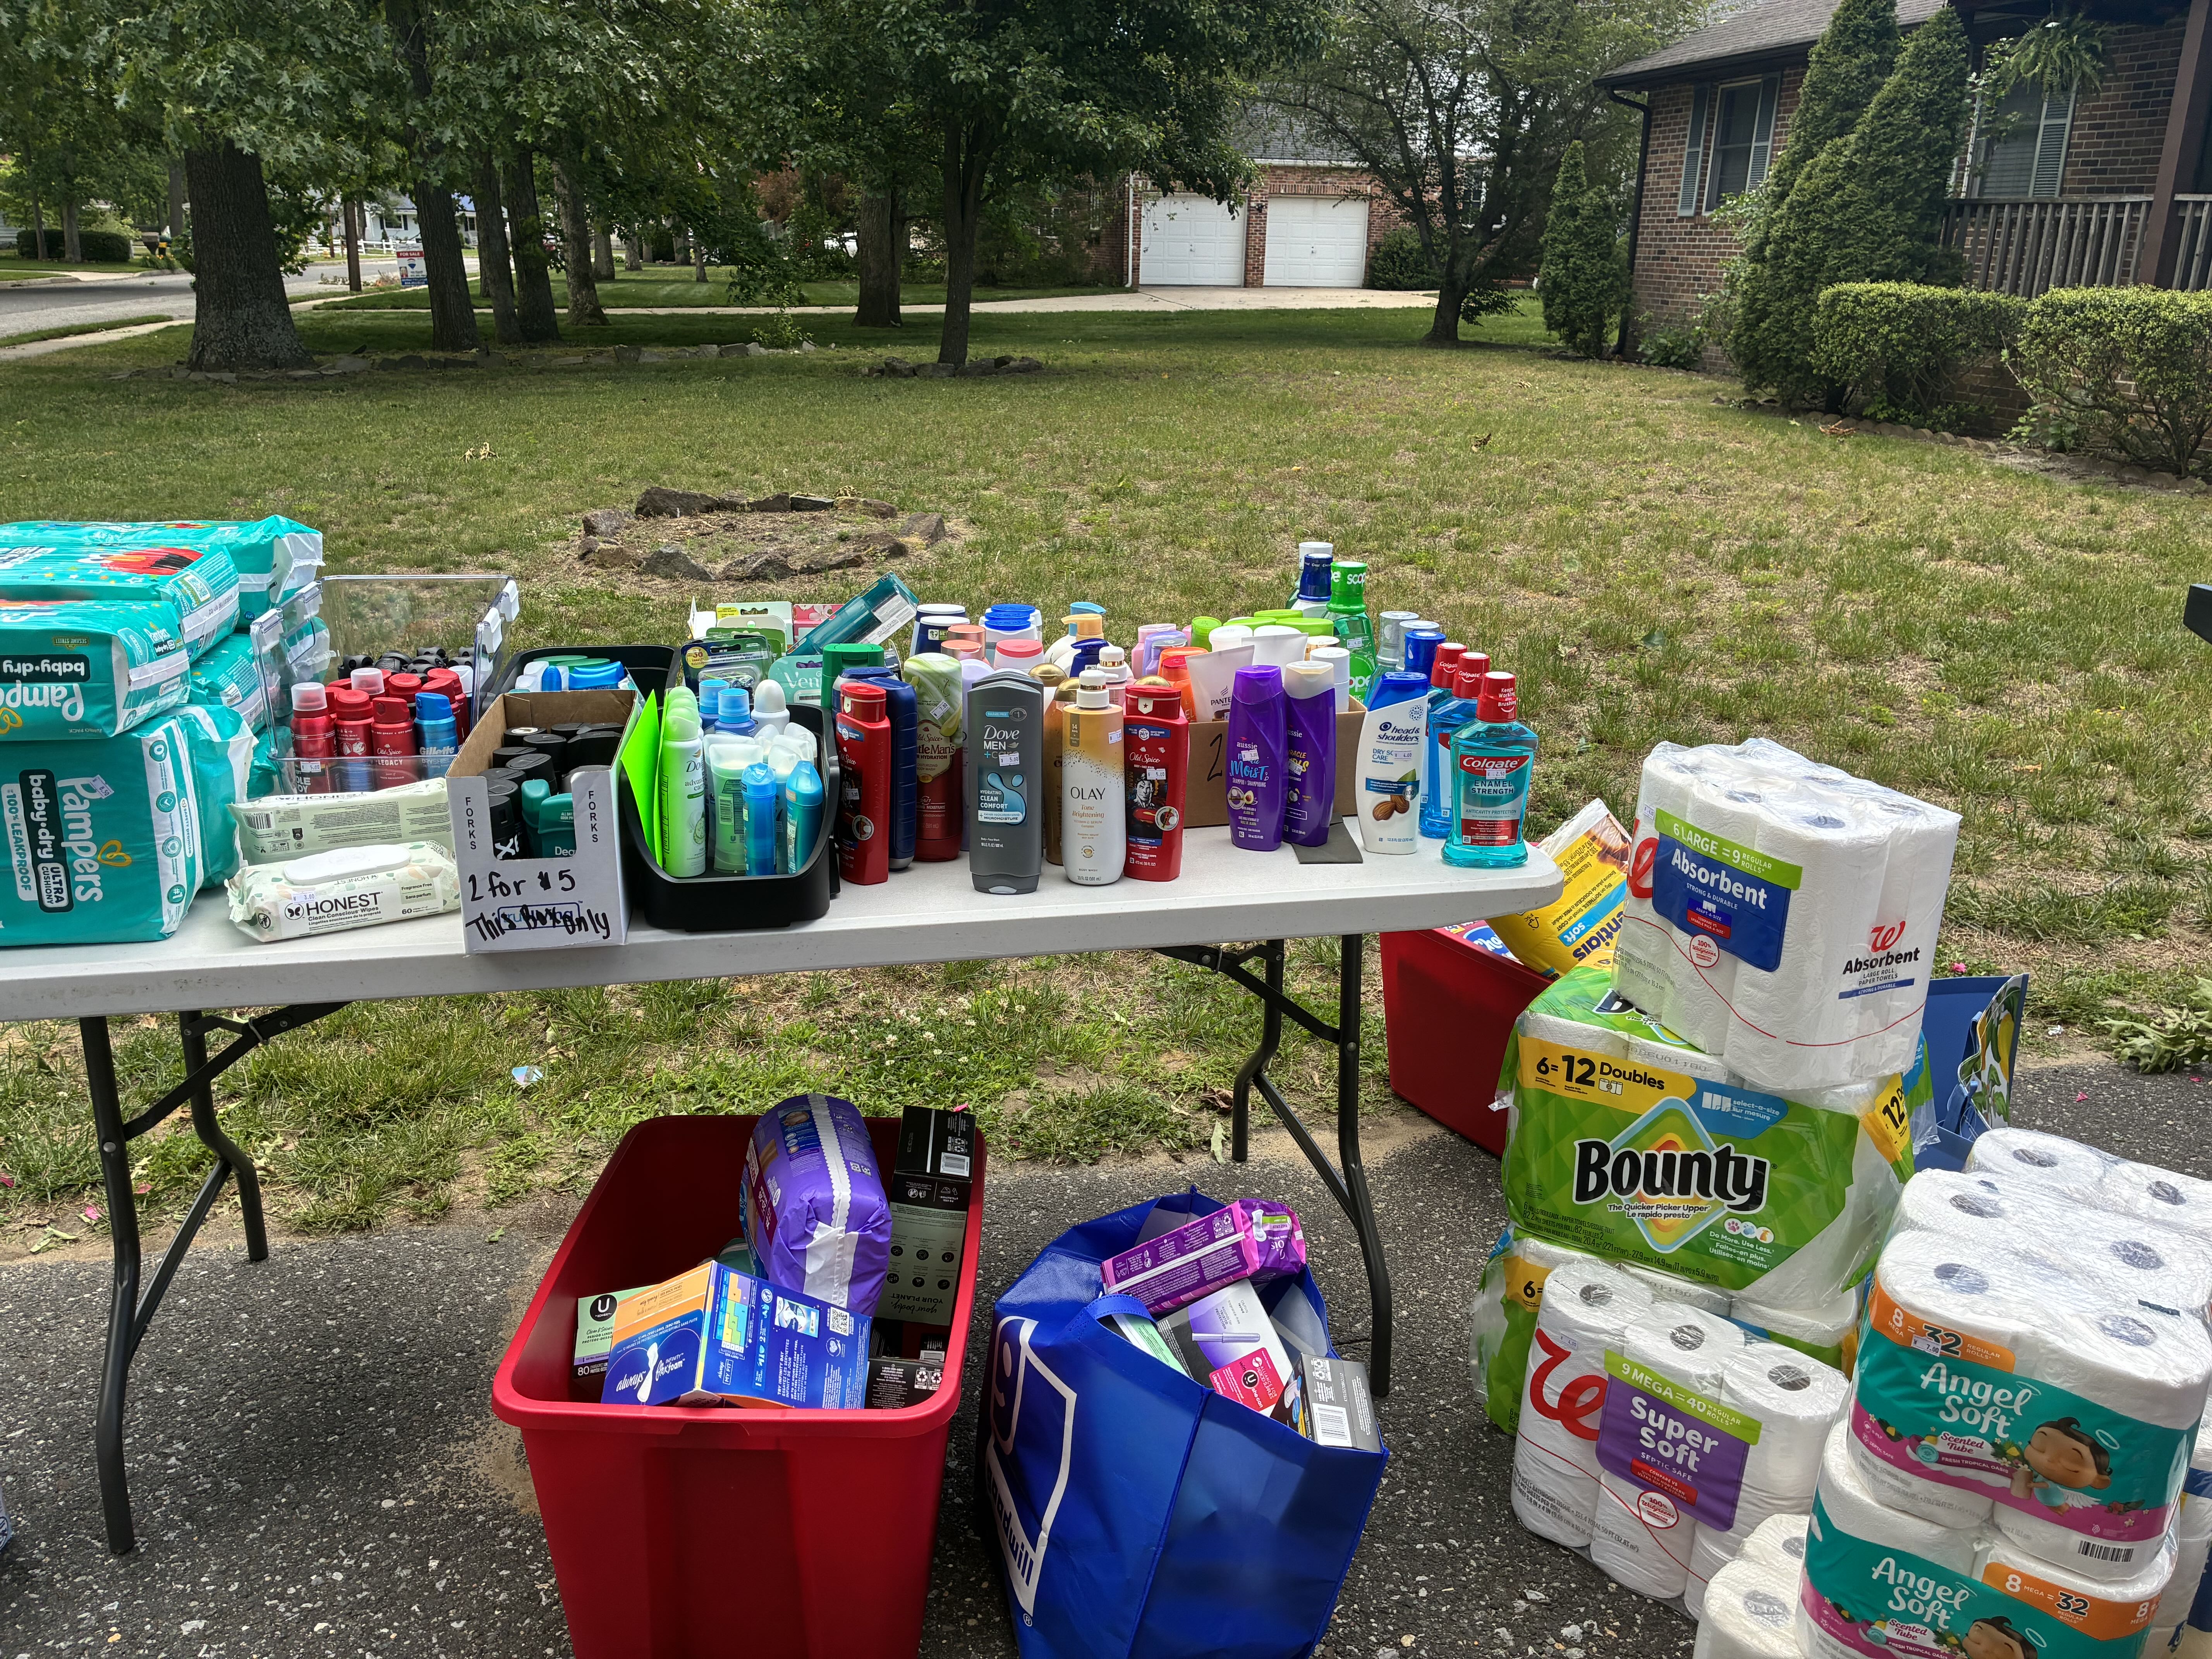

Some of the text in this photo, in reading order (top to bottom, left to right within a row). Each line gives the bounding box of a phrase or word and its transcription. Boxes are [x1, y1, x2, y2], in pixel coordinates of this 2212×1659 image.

[783, 671, 822, 689] Ven
[0, 680, 84, 721] Pamp
[1211, 697, 1232, 706] PANTE
[984, 725, 1020, 740] Dove
[1288, 730, 1302, 738] ussie
[1377, 734, 1419, 742] shoulders
[386, 747, 402, 756] Spice
[984, 740, 1006, 750] MEN
[1129, 752, 1160, 764] Old Spice
[1463, 757, 1518, 770] Colgate
[1232, 777, 1245, 786] SHAMPOO
[99, 785, 110, 797] 8.50
[1070, 787, 1106, 800] OLAY
[6, 793, 19, 821] 100%
[1072, 811, 1104, 819] Brightening
[465, 797, 477, 850] FORKS
[589, 790, 598, 843] FORKS
[58, 777, 103, 902] Pampers
[1673, 823, 1741, 864] 6 LARGE 9
[11, 823, 32, 891] LEAKPROOF
[1742, 853, 1772, 870] REGULAR
[42, 866, 54, 905] CUSHIONY
[50, 866, 64, 903] ULTRA
[334, 876, 369, 886] HONEST
[468, 874, 484, 902] 2
[488, 871, 526, 898] for
[1671, 848, 1767, 910] Absorbent
[1563, 870, 1616, 917] Encore plus DOUCEUR PRIX
[1686, 882, 1738, 910] STRONG DURABLE
[306, 891, 381, 916] HONEST
[326, 910, 359, 918] Conscious
[1573, 908, 1583, 918] Small
[1696, 907, 1722, 921] ADAPT-A-SIZE
[465, 912, 517, 942] This
[1557, 920, 1569, 931] COST
[1563, 922, 1586, 944] soft
[1692, 945, 1717, 957] Walgreens
[1697, 940, 1711, 948] 100%
[1842, 947, 1920, 975] Absorbent
[1859, 973, 1898, 986] PAPER TOWELS
[1863, 970, 1880, 979] LARGE
[1599, 1061, 1665, 1090] Doubles
[1733, 1099, 1780, 1116] select-a-size
[1745, 1110, 1771, 1121] mesure
[1882, 1096, 1905, 1130] 12
[1574, 1139, 1768, 1212] Bounty
[1637, 1211, 1662, 1219] rapido
[1721, 1233, 1740, 1245] More.
[1741, 1240, 1754, 1249] Use
[1632, 1250, 1665, 1267] 27.9 14.9
[1709, 1247, 1746, 1263] Utilisez-en
[1716, 1242, 1766, 1262] Faites-en plus.
[598, 1298, 610, 1313] U
[891, 1293, 921, 1302] PLANET
[916, 1303, 937, 1314] your
[1215, 1308, 1226, 1329] PROTECTION
[1892, 1308, 1904, 1328] 8
[1888, 1320, 1904, 1338] MEGA
[1926, 1344, 1939, 1353] 7.00
[1967, 1343, 2001, 1358] REGULAR
[578, 1366, 590, 1376] 80
[655, 1359, 683, 1381] flexfoam
[724, 1372, 730, 1382] MY
[1260, 1366, 1272, 1387] ALLIANCE
[616, 1371, 644, 1392] always
[1621, 1363, 1707, 1413] 9 MEGA 40
[1920, 1362, 2032, 1416] Angel
[1708, 1405, 1741, 1425] REGULAR
[1939, 1395, 2011, 1439] Soft
[1630, 1396, 1719, 1454] Super
[1940, 1432, 1985, 1449] Scented
[1947, 1442, 1975, 1454] Tube
[1639, 1427, 1700, 1472] Soft
[1869, 1441, 1894, 1460] SEPTIC SAFE
[1641, 1452, 1693, 1481] SEPTIC SAFE
[1941, 1456, 2009, 1474] FRESH TROPICAL OASIS
[1649, 1469, 1671, 1483] COMPARE
[1641, 1499, 1675, 1519] Walgreens
[1649, 1497, 1668, 1509] 100%
[1587, 1517, 1602, 1531] TOTAL
[1871, 1557, 1970, 1611] Angel
[2005, 1573, 2090, 1618] 8 MEGA 32
[1887, 1586, 1951, 1629] Soft
[2057, 1610, 2083, 1621] REGULAR
[2136, 1601, 2150, 1618] 8
[1889, 1619, 1928, 1636] Scented
[2130, 1616, 2148, 1625] MEGA
[1894, 1628, 1918, 1641] Tube
[1888, 1641, 1931, 1656] FRESH TROPICAL
